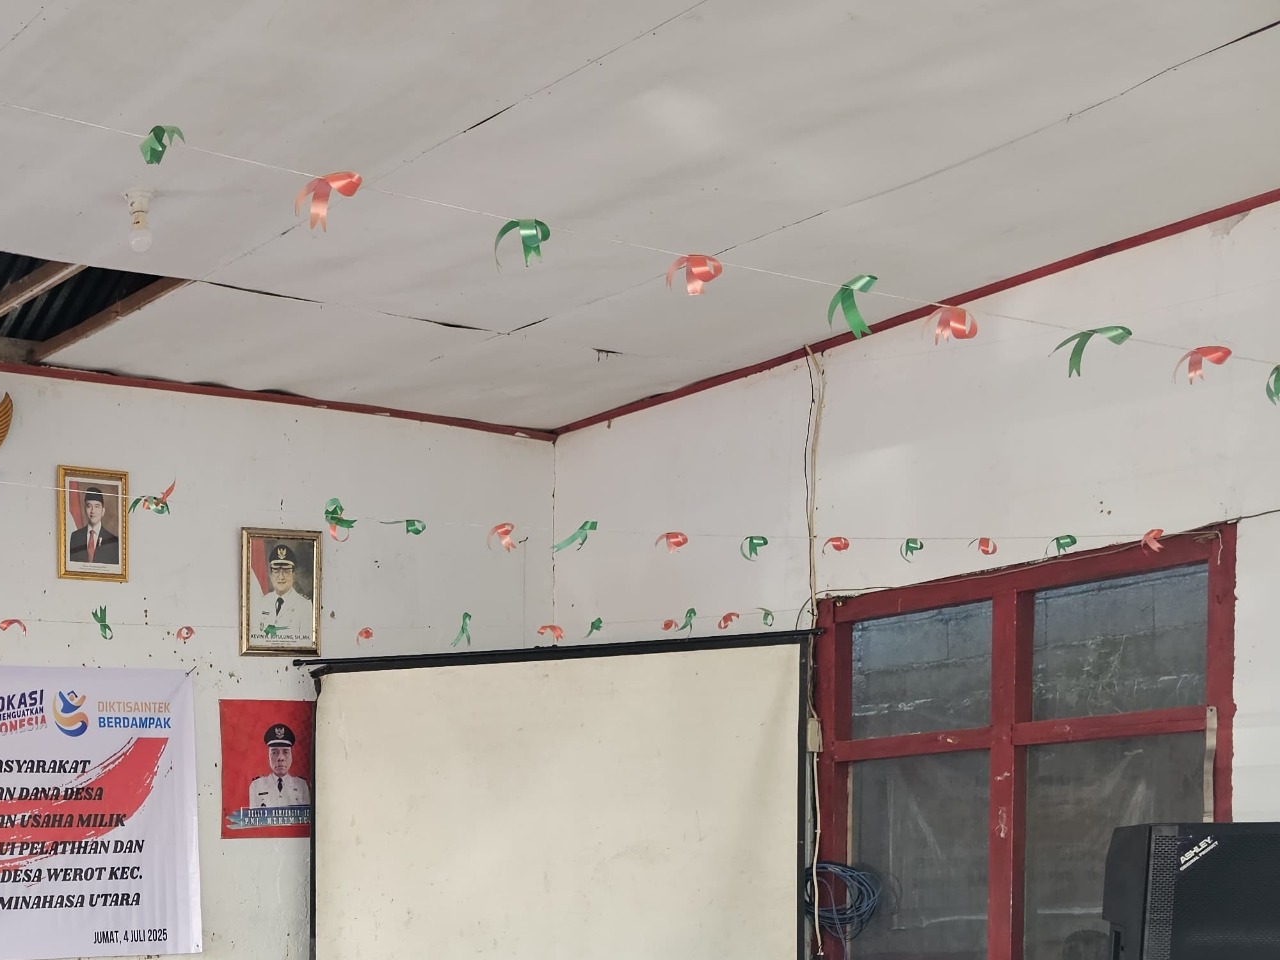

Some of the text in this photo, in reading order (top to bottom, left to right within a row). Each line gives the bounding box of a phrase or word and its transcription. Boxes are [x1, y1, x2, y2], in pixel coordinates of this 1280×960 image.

[97, 701, 171, 713] DIKTISAINTEK
[97, 716, 172, 729] BERDAMPAK
[19, 786, 61, 801] DANA
[62, 786, 104, 801] DESA
[20, 813, 74, 828] USAHA
[76, 813, 127, 828] MILIK
[18, 840, 111, 856] PELATIHAN
[112, 839, 145, 854] DAN
[1180, 836, 1211, 864] ASHLEY
[0, 868, 43, 883] DESA
[46, 866, 106, 882] WEROT
[107, 866, 143, 880] KEC.
[88, 892, 141, 907] UTARA
[93, 928, 168, 945] JUMAT, 4 JULI 2025
